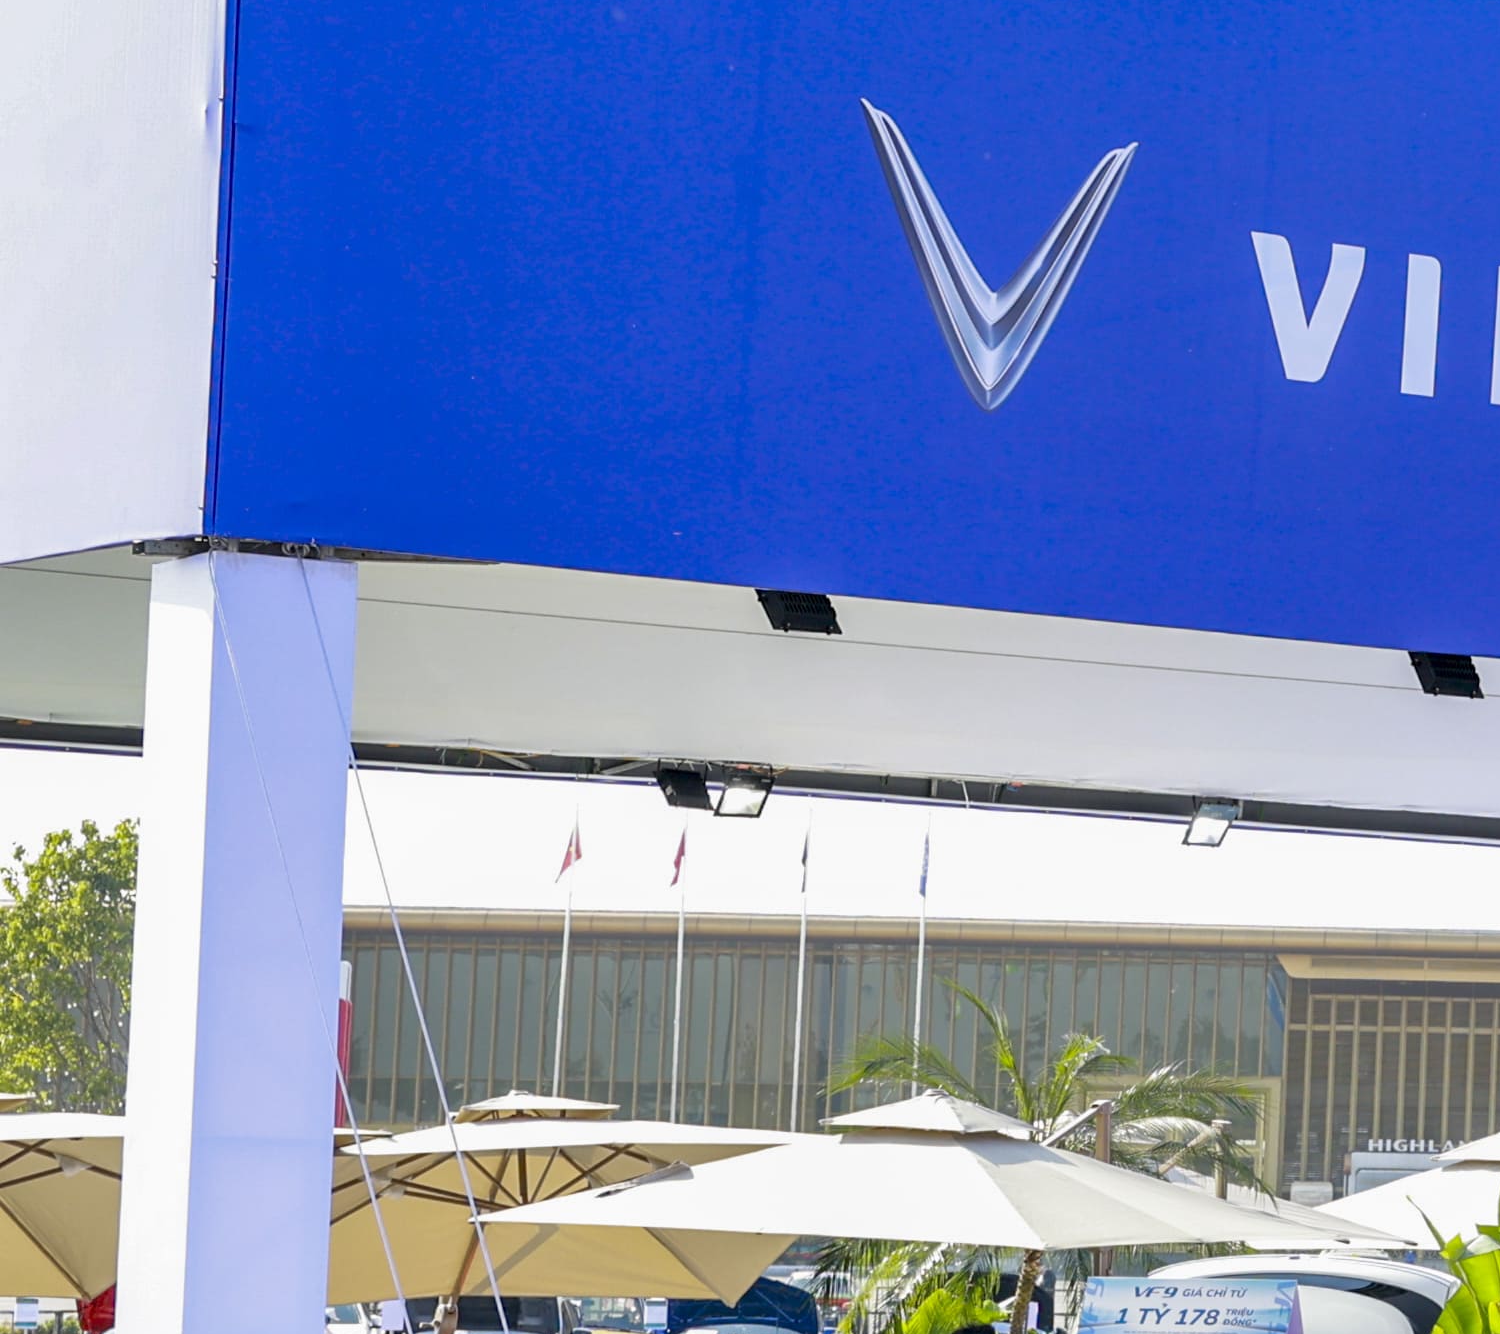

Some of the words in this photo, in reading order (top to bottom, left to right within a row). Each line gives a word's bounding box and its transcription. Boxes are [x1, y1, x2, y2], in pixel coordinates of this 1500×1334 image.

[1134, 1285, 1178, 1299] VF9
[1182, 1285, 1203, 1298] GIÁ
[1206, 1285, 1229, 1298] CHỈ
[1230, 1286, 1248, 1298] TỪ
[1115, 1308, 1130, 1324] 1
[1139, 1303, 1171, 1325] TỶ
[1174, 1308, 1220, 1326] 178
